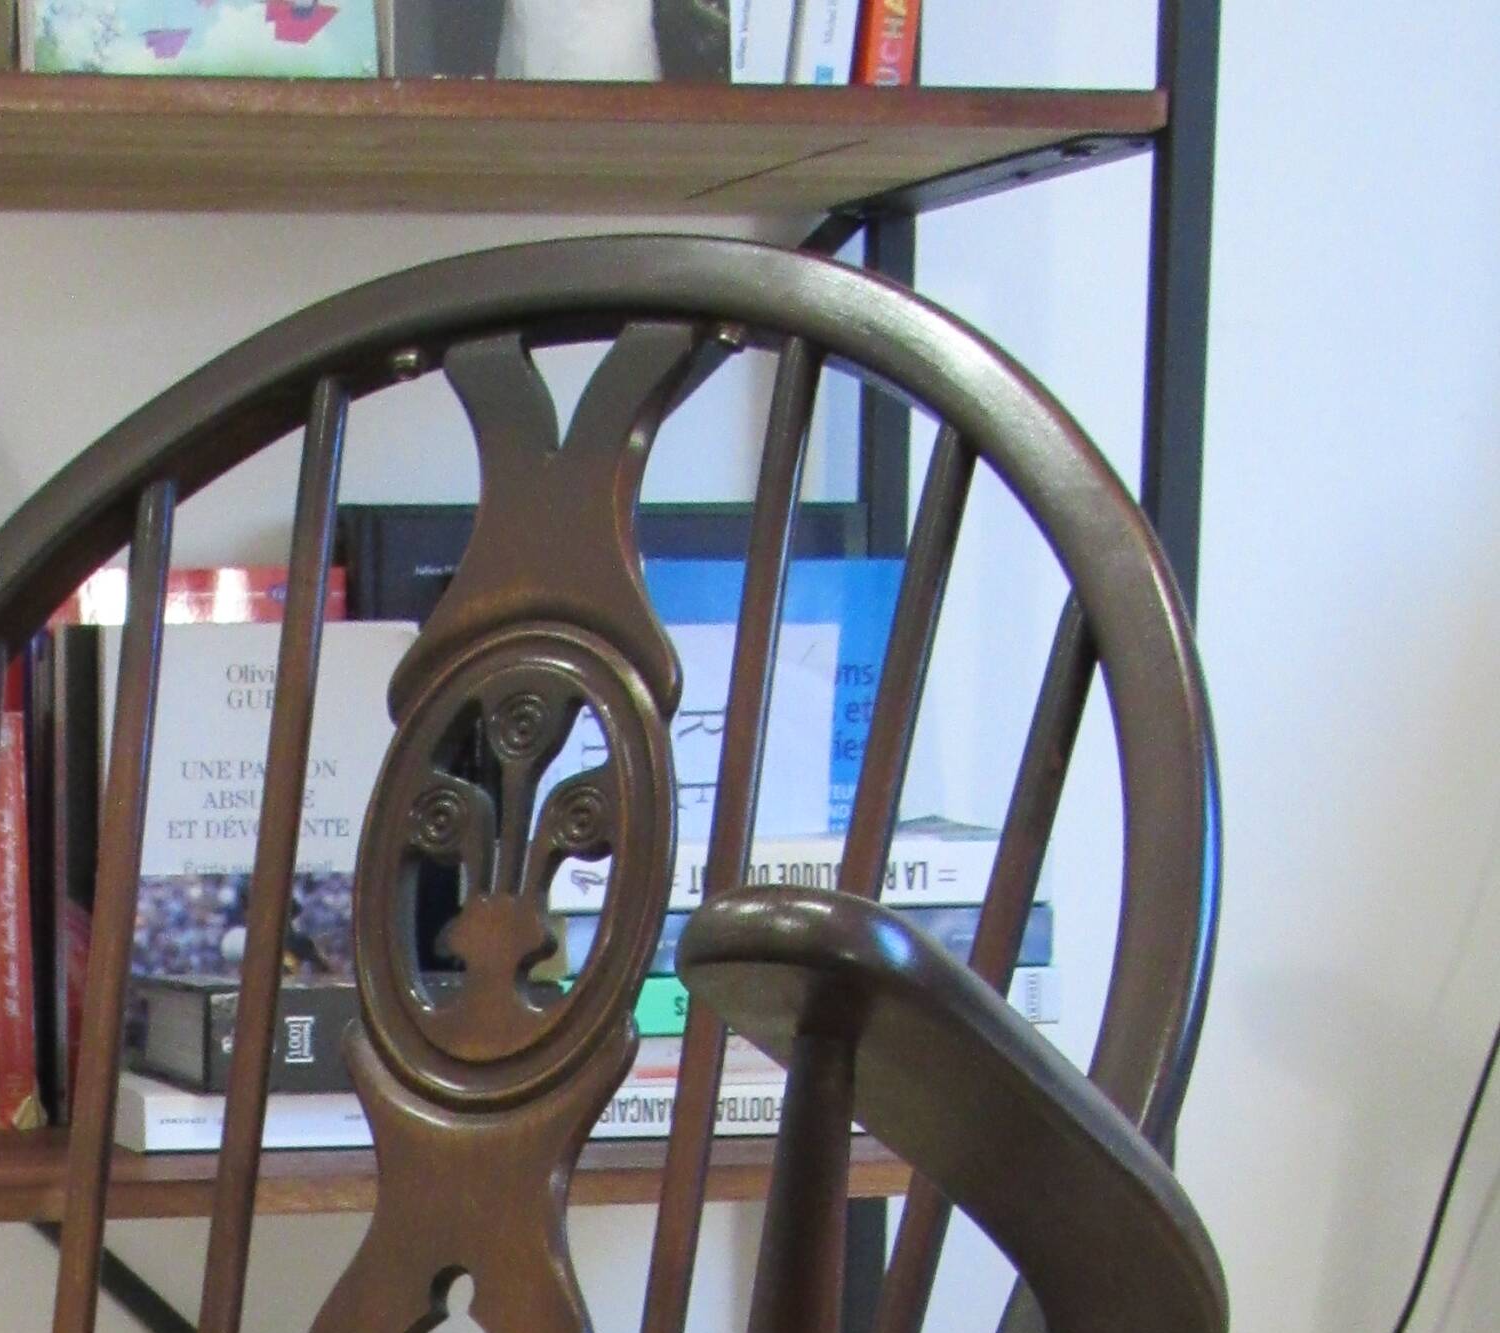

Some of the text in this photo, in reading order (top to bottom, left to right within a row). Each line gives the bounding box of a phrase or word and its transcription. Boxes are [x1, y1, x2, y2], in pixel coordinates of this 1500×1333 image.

[180, 760, 231, 780] UNE
[168, 819, 197, 840] ET
[905, 860, 929, 890] LA
